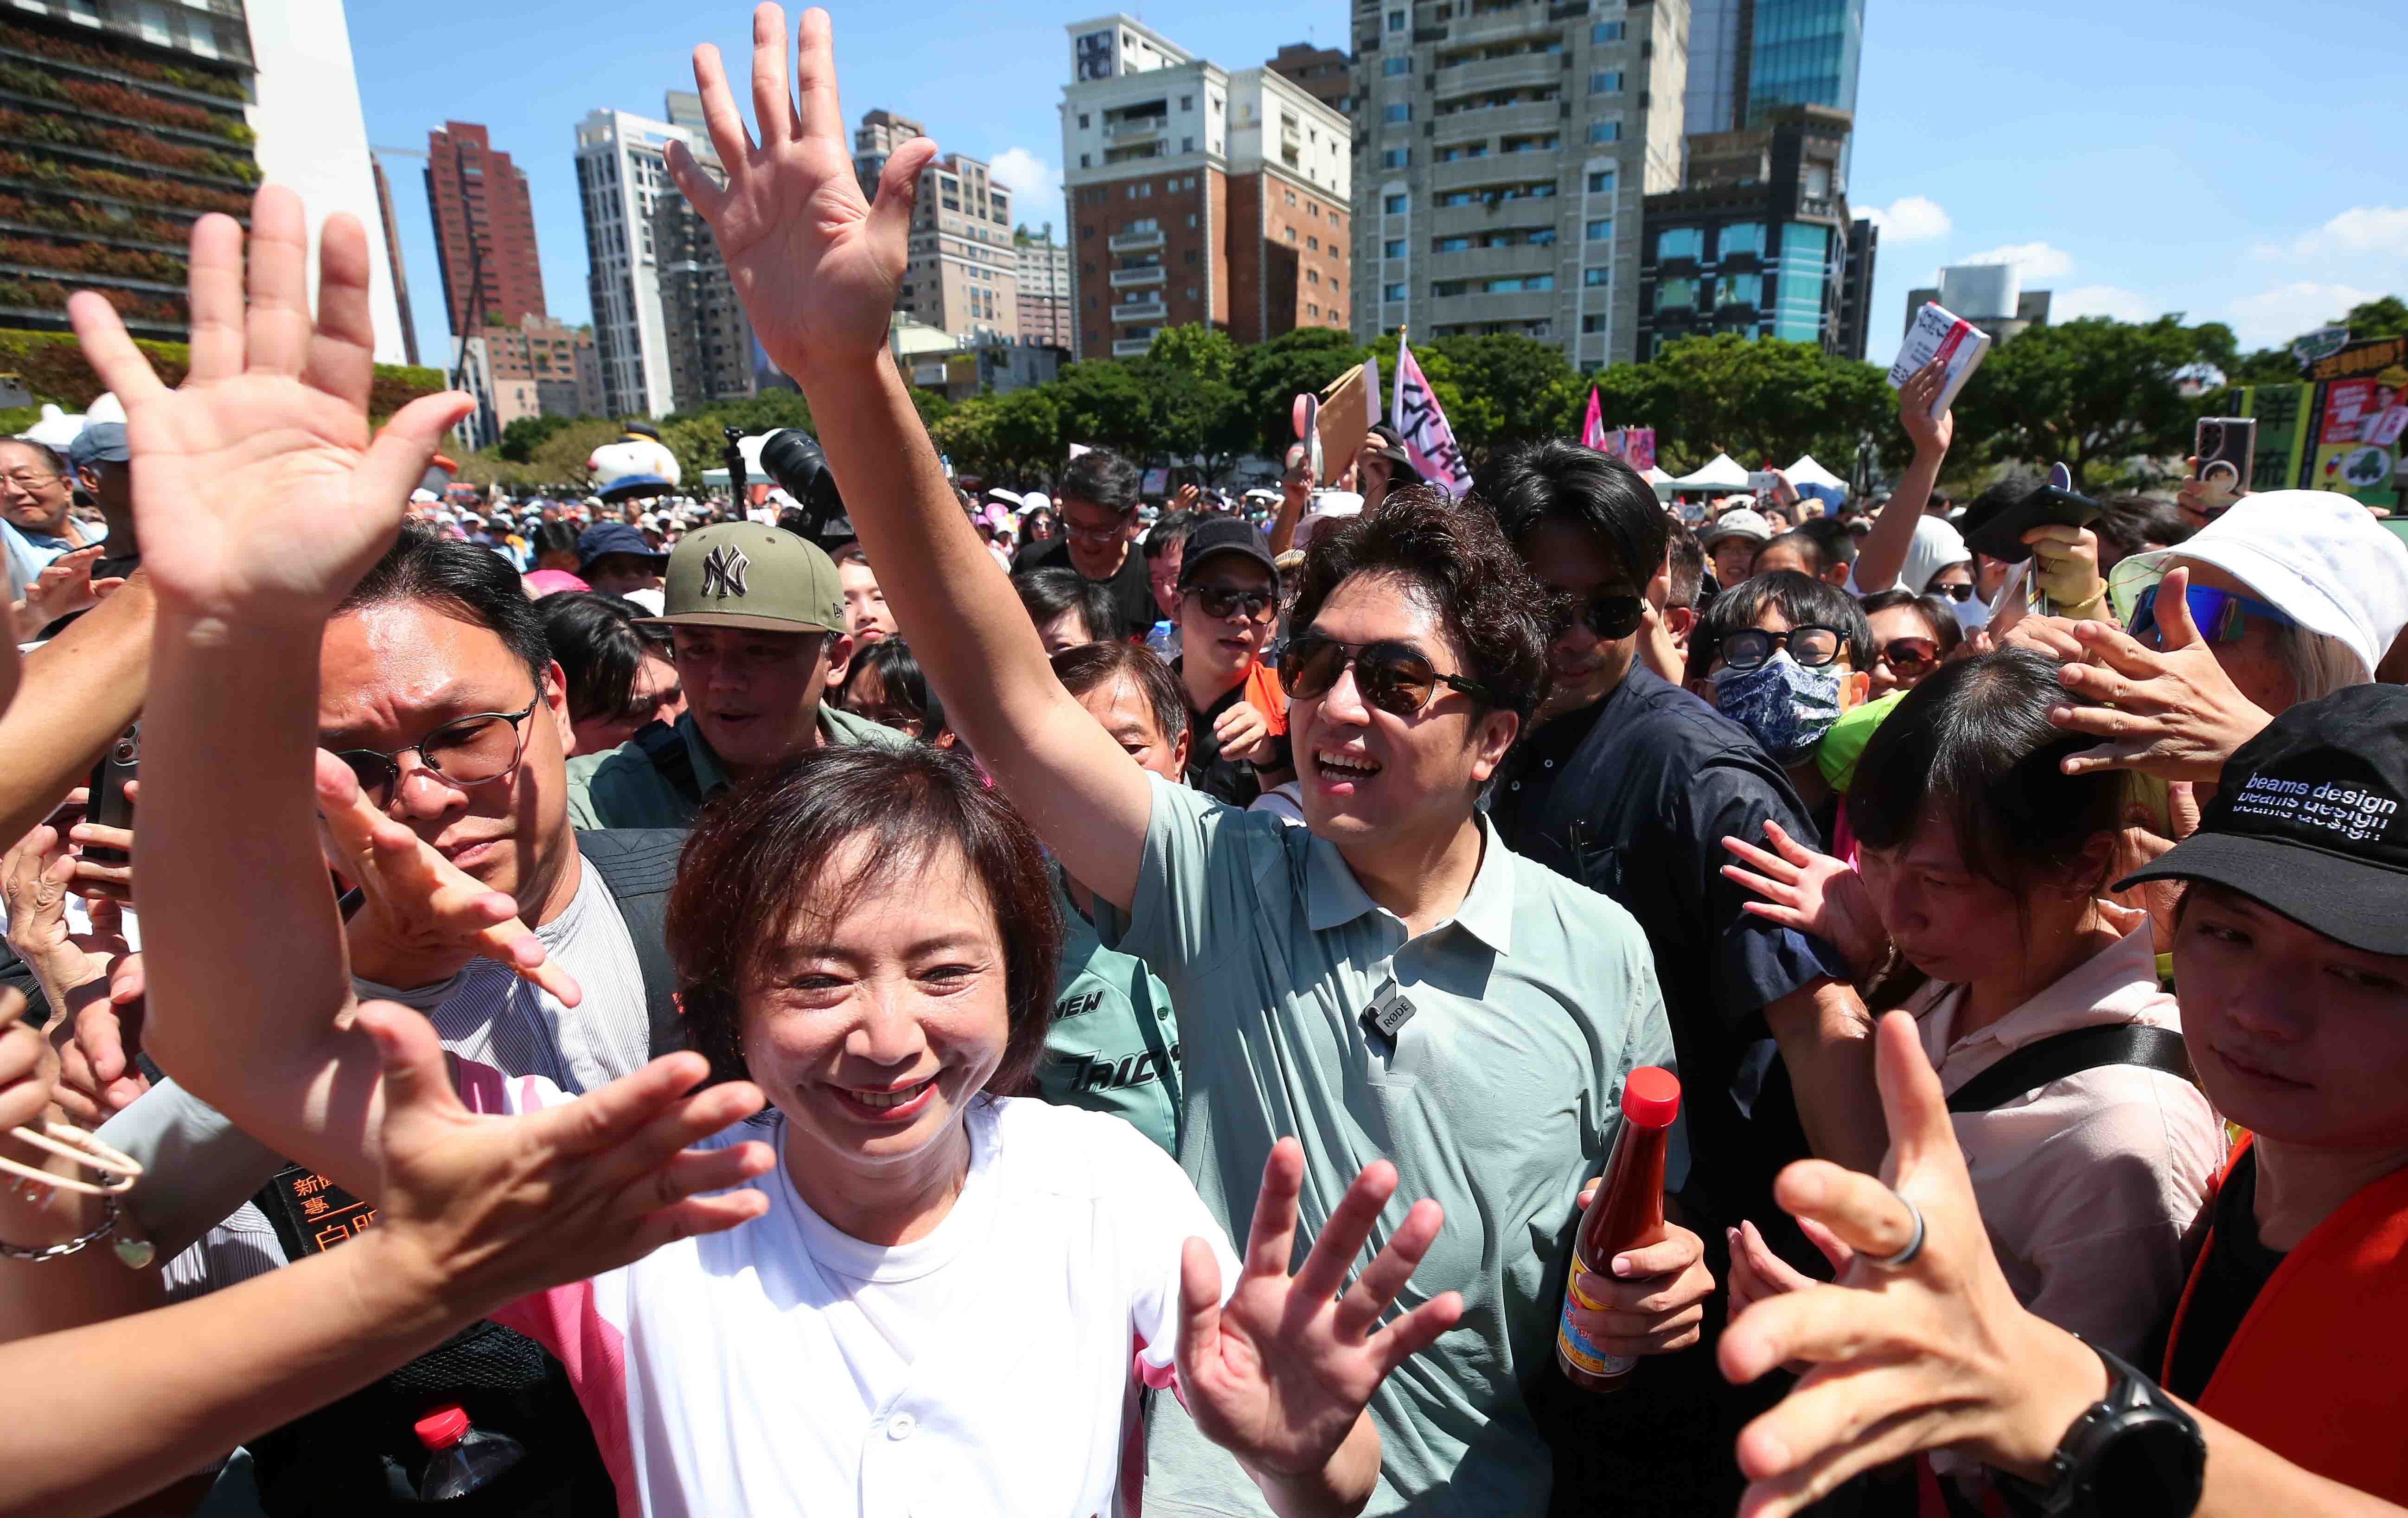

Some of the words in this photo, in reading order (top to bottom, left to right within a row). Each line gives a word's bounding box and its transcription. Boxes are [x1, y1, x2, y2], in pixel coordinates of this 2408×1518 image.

[2245, 772, 2310, 795] beams
[2312, 781, 2398, 814] design
[1383, 1002, 1410, 1028] RØDE
